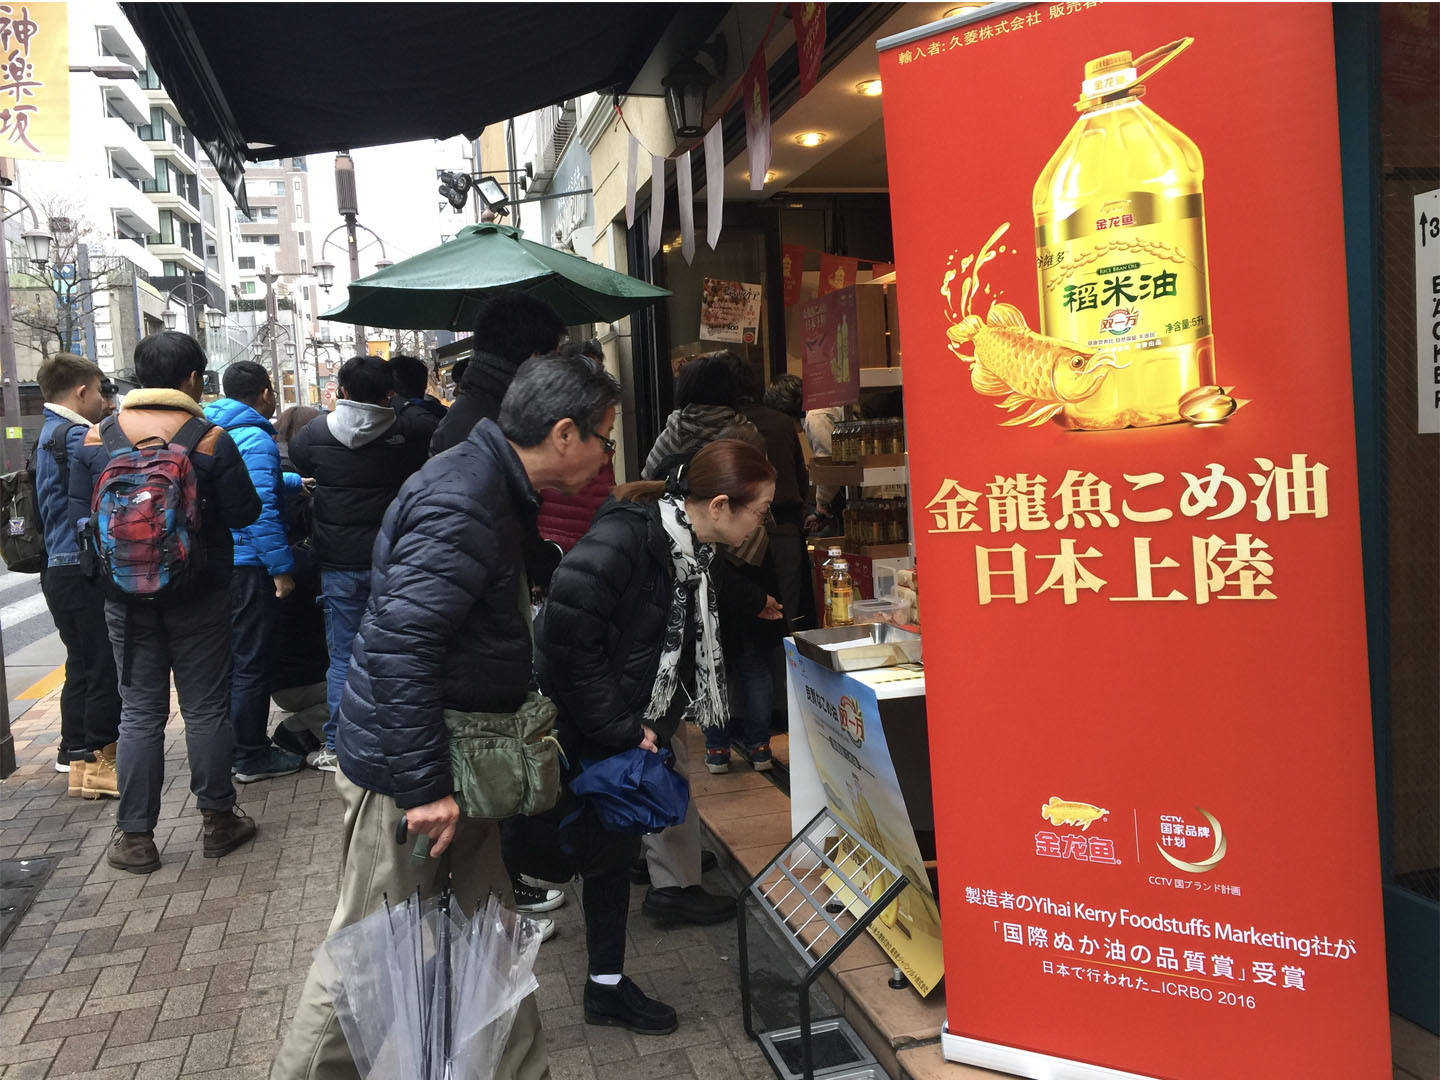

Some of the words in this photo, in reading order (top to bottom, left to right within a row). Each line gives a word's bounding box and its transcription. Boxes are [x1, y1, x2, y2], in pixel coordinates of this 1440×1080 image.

[0, 6, 43, 153] 神楽坂
[1096, 214, 1134, 231] 金龙鱼
[1063, 269, 1178, 313] 稻米油
[925, 454, 1330, 534] 金龍魚こめ油
[974, 534, 1278, 605] 日本上陸
[1160, 822, 1211, 838] 国家品牌
[1162, 836, 1186, 848] 计划
[1035, 831, 1116, 865] 金龙鱼
[1149, 875, 1172, 887] CCTV
[1075, 902, 1117, 928] Kerry
[1120, 908, 1211, 939] Foodstuffs
[1218, 991, 1256, 1009] 2016
